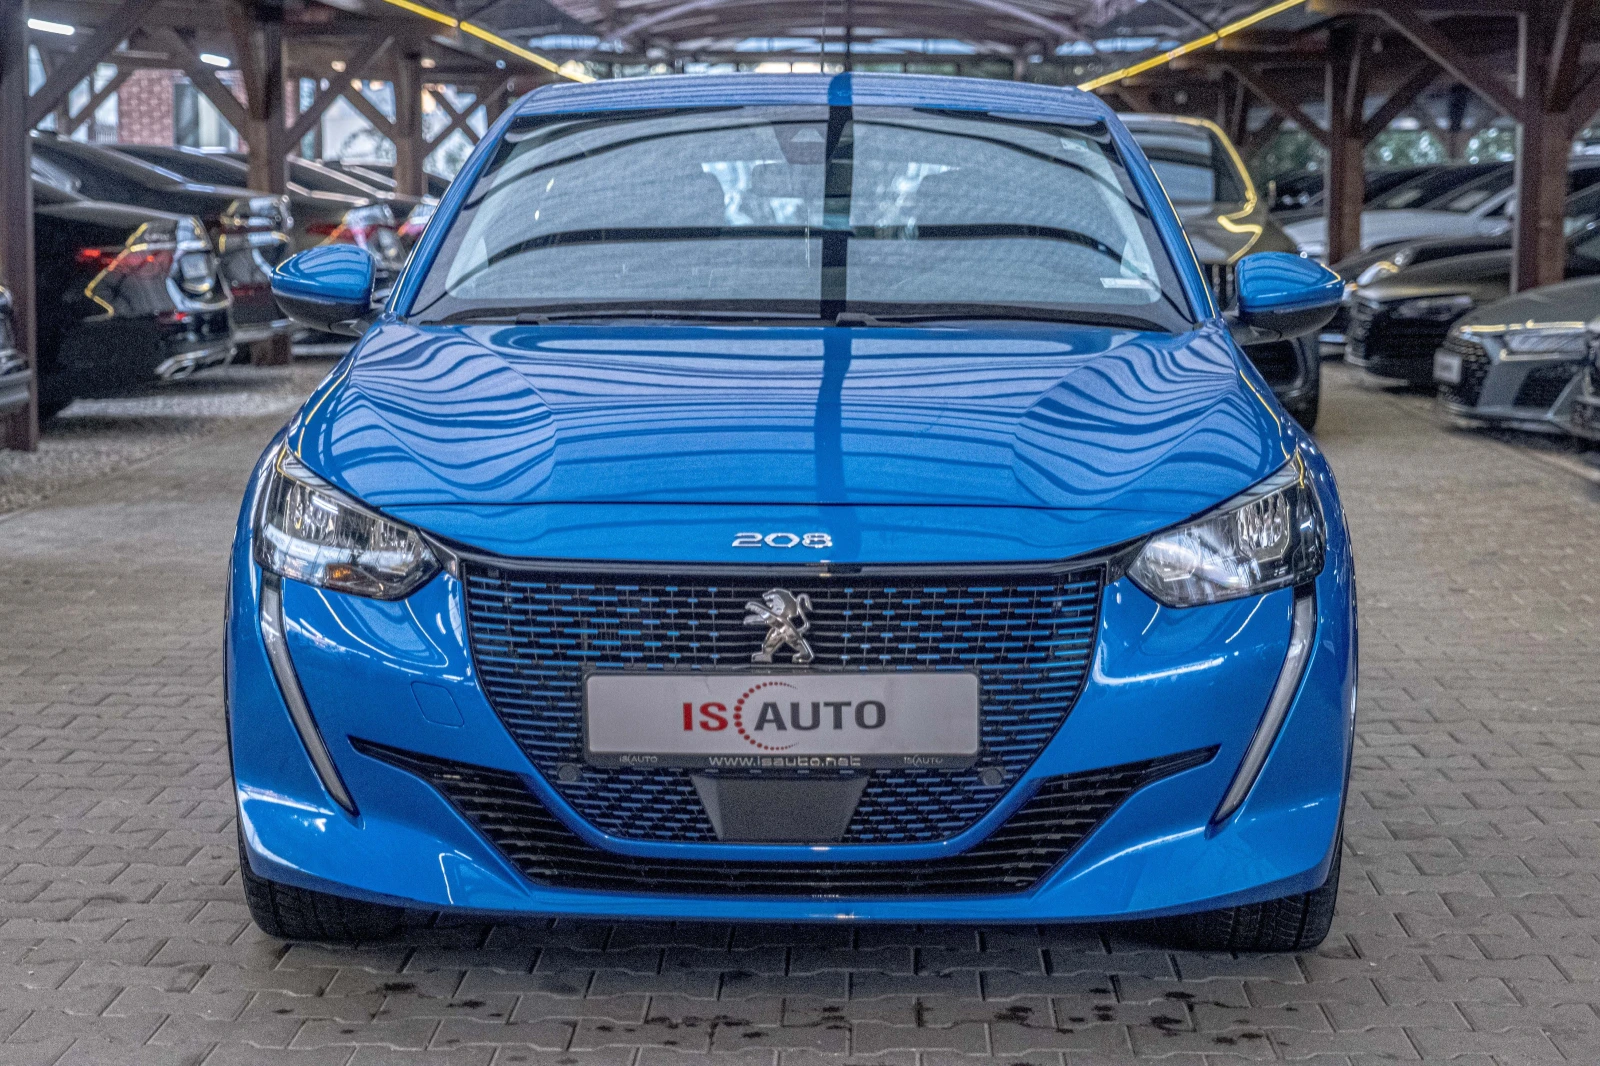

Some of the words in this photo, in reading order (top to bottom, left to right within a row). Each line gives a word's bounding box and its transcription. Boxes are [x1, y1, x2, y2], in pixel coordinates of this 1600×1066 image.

[731, 532, 833, 548] 208
[683, 702, 729, 732] IS
[753, 700, 886, 732] AUTO
[708, 755, 861, 767] www.isauto.net
